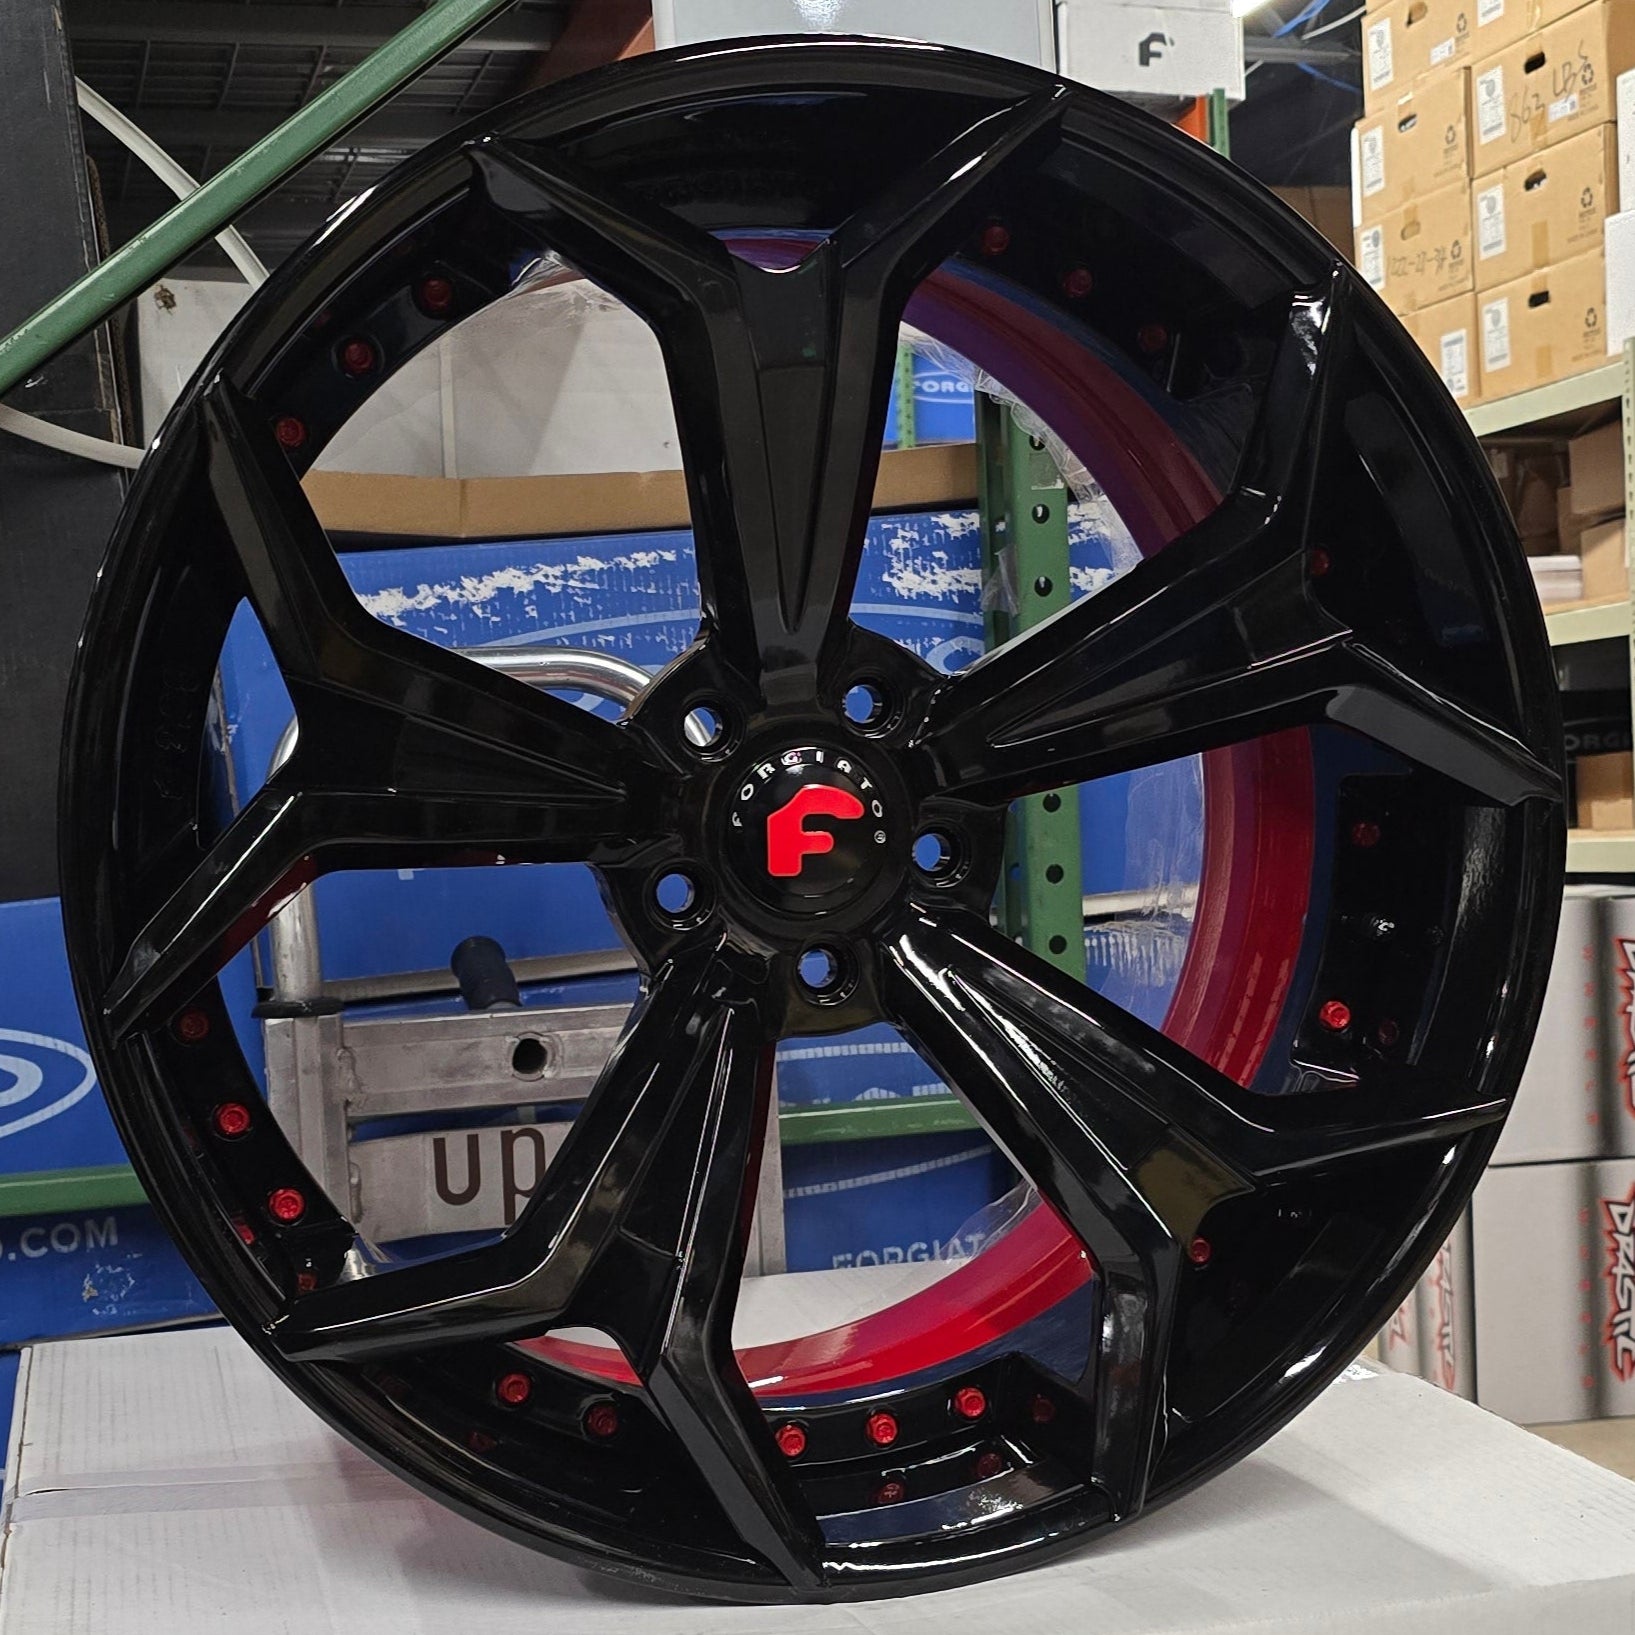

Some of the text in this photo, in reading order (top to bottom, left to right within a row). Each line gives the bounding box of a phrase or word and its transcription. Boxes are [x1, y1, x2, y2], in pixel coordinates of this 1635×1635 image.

[731, 750, 883, 828] FORGIATO
[767, 784, 864, 877] F
[0, 1216, 118, 1261] .COM
